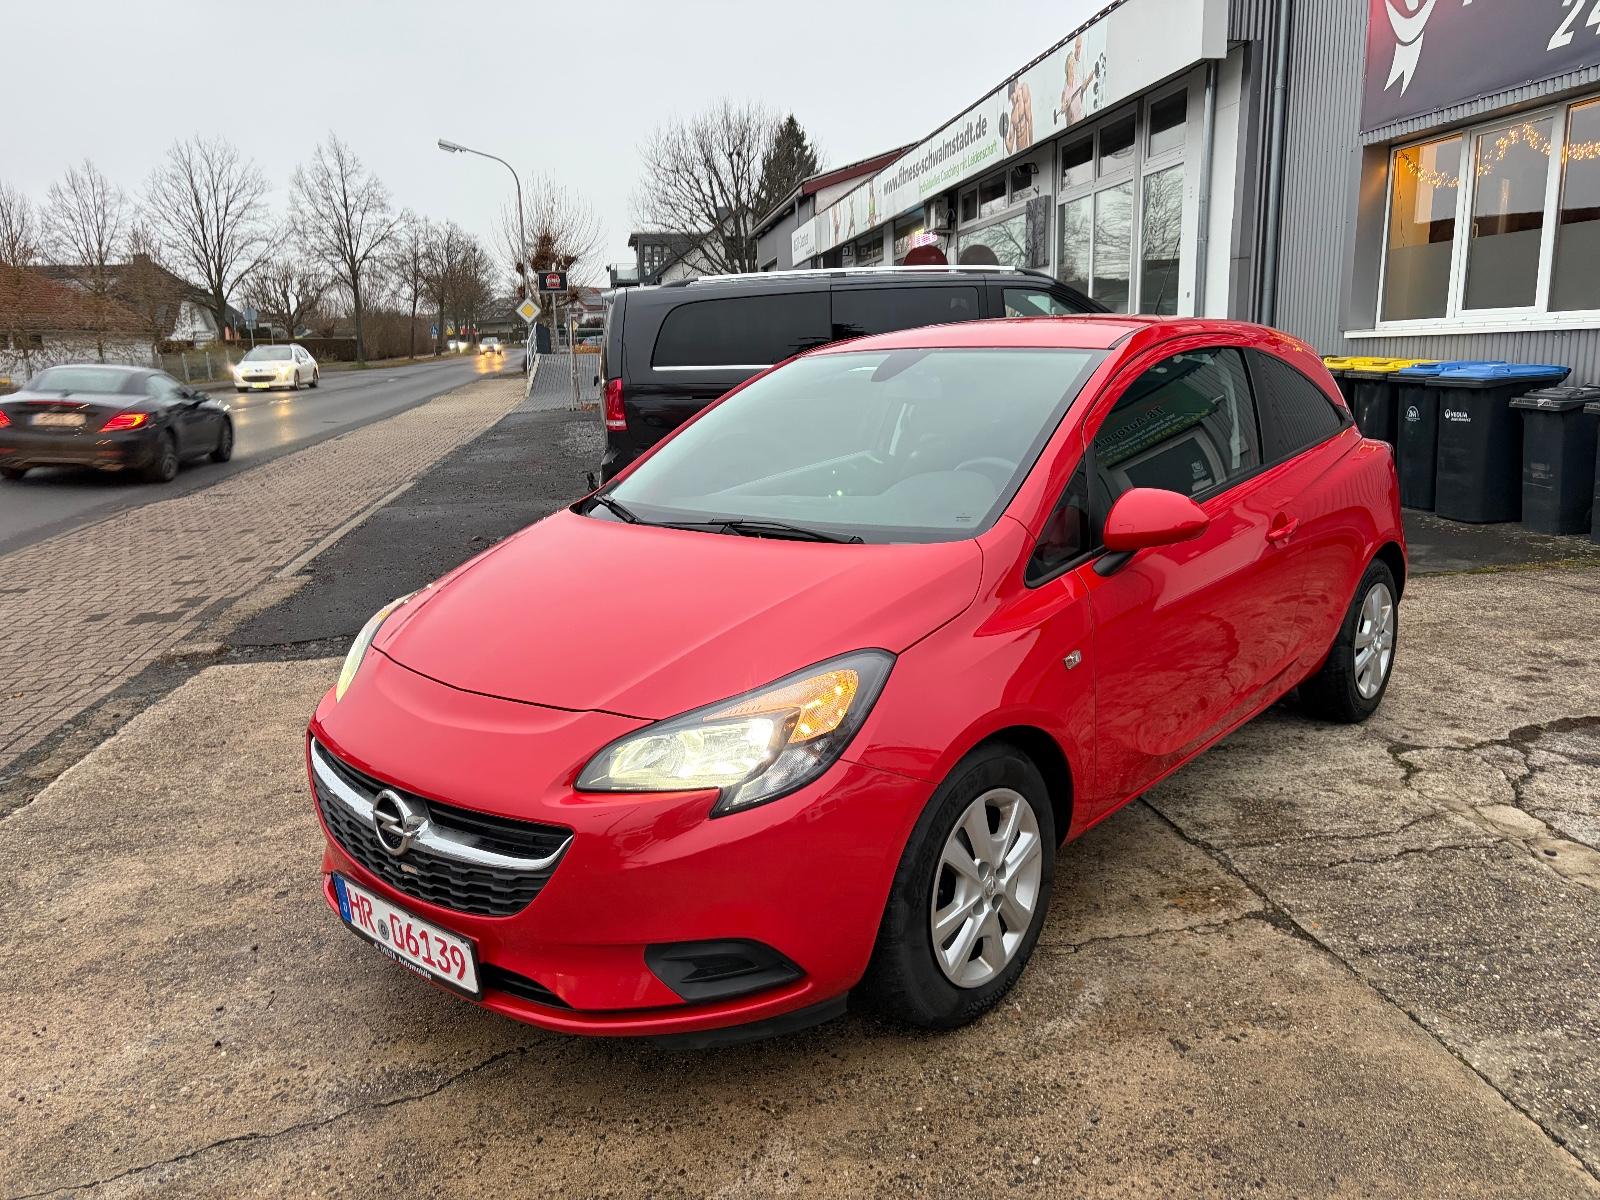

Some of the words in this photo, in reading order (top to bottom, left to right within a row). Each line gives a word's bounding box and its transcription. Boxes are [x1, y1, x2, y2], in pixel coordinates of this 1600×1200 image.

[883, 113, 988, 196] www.fitness-schwalmstadt.de
[347, 886, 377, 934] HR
[389, 913, 466, 980] 06139
